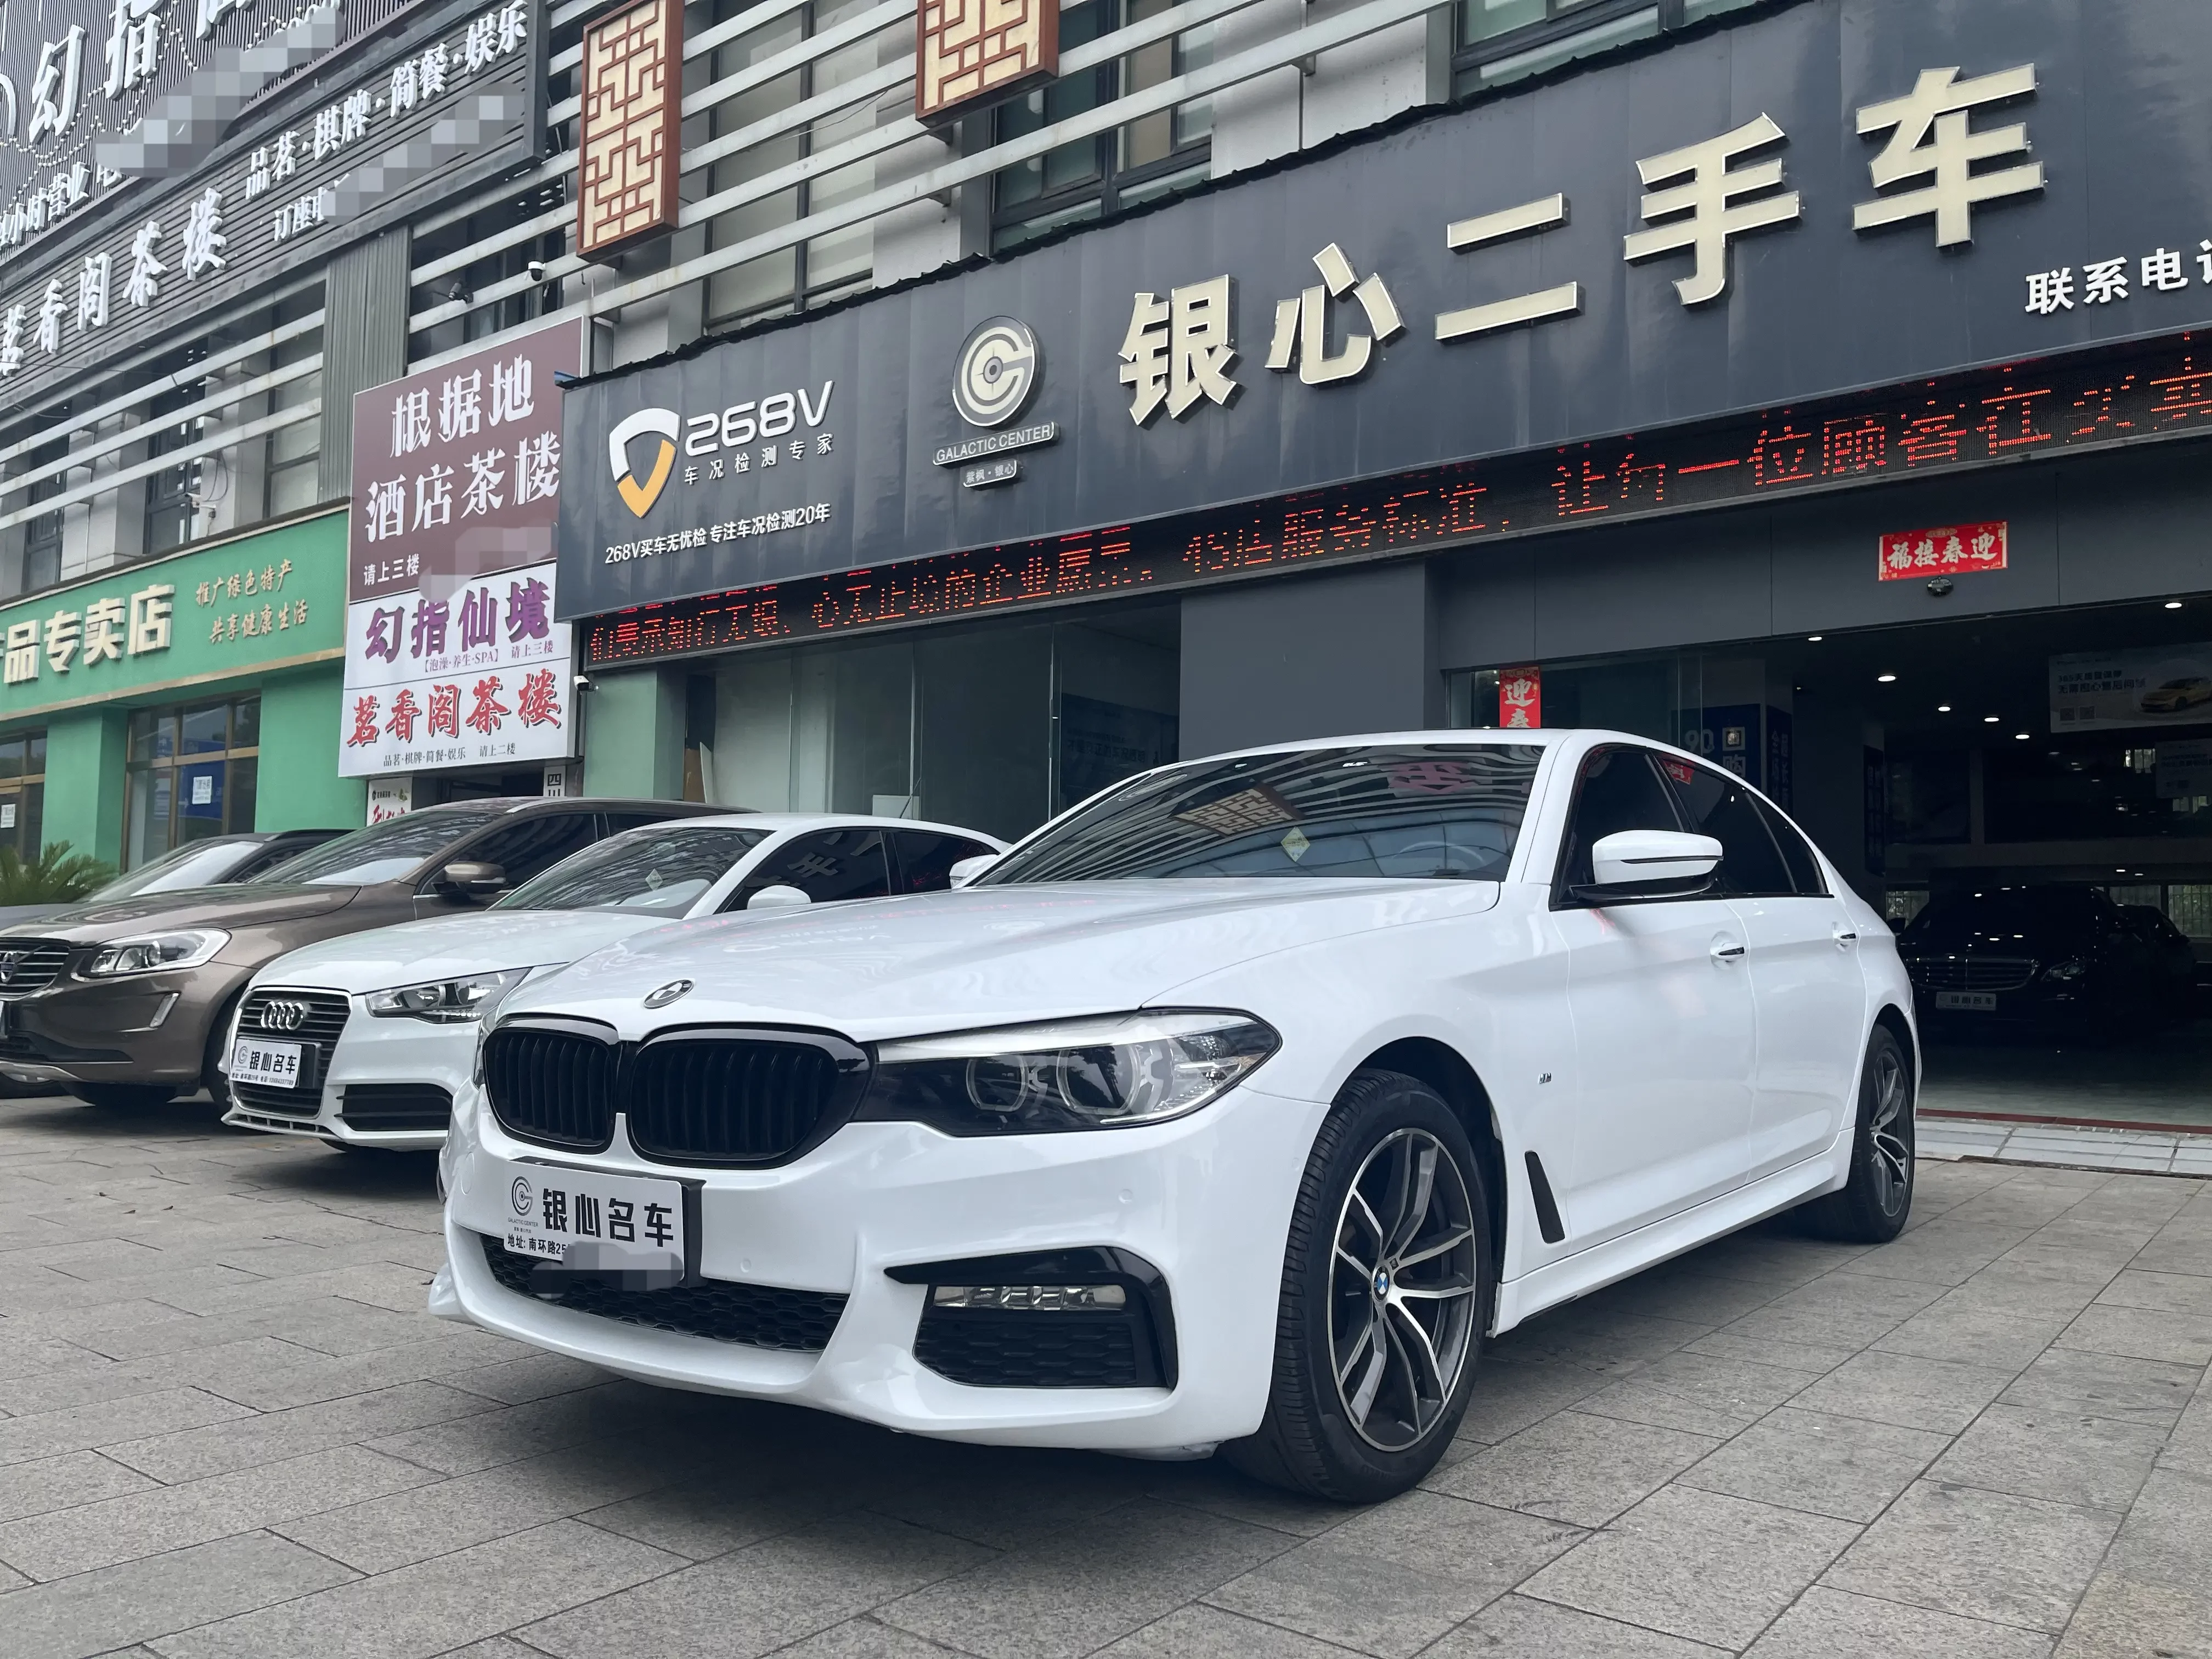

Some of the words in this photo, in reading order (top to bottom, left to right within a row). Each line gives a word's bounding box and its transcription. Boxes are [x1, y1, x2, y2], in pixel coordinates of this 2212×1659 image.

[1117, 63, 2045, 426] 银心二手车
[390, 353, 535, 458] 根据地
[685, 380, 834, 457] 268V
[684, 433, 834, 485] 车况检测专家
[936, 437, 996, 462] GALACTIC
[999, 424, 1051, 448] CENTER
[364, 430, 561, 543] 酒店茶楼
[605, 527, 707, 565] 268V买车无忧检
[709, 503, 832, 544] 专注车况检测20年
[363, 552, 420, 586] 请上三楼
[0, 584, 176, 685] 品专卖店
[365, 577, 550, 664] 幻指仙境
[511, 640, 554, 659] 请上三楼
[347, 669, 562, 748] 茗香阁茶楼
[479, 742, 516, 758] 请上二楼
[249, 1050, 297, 1075] 银心名车
[528, 1237, 571, 1255] 南环路25
[542, 1187, 674, 1248] 银心名车
